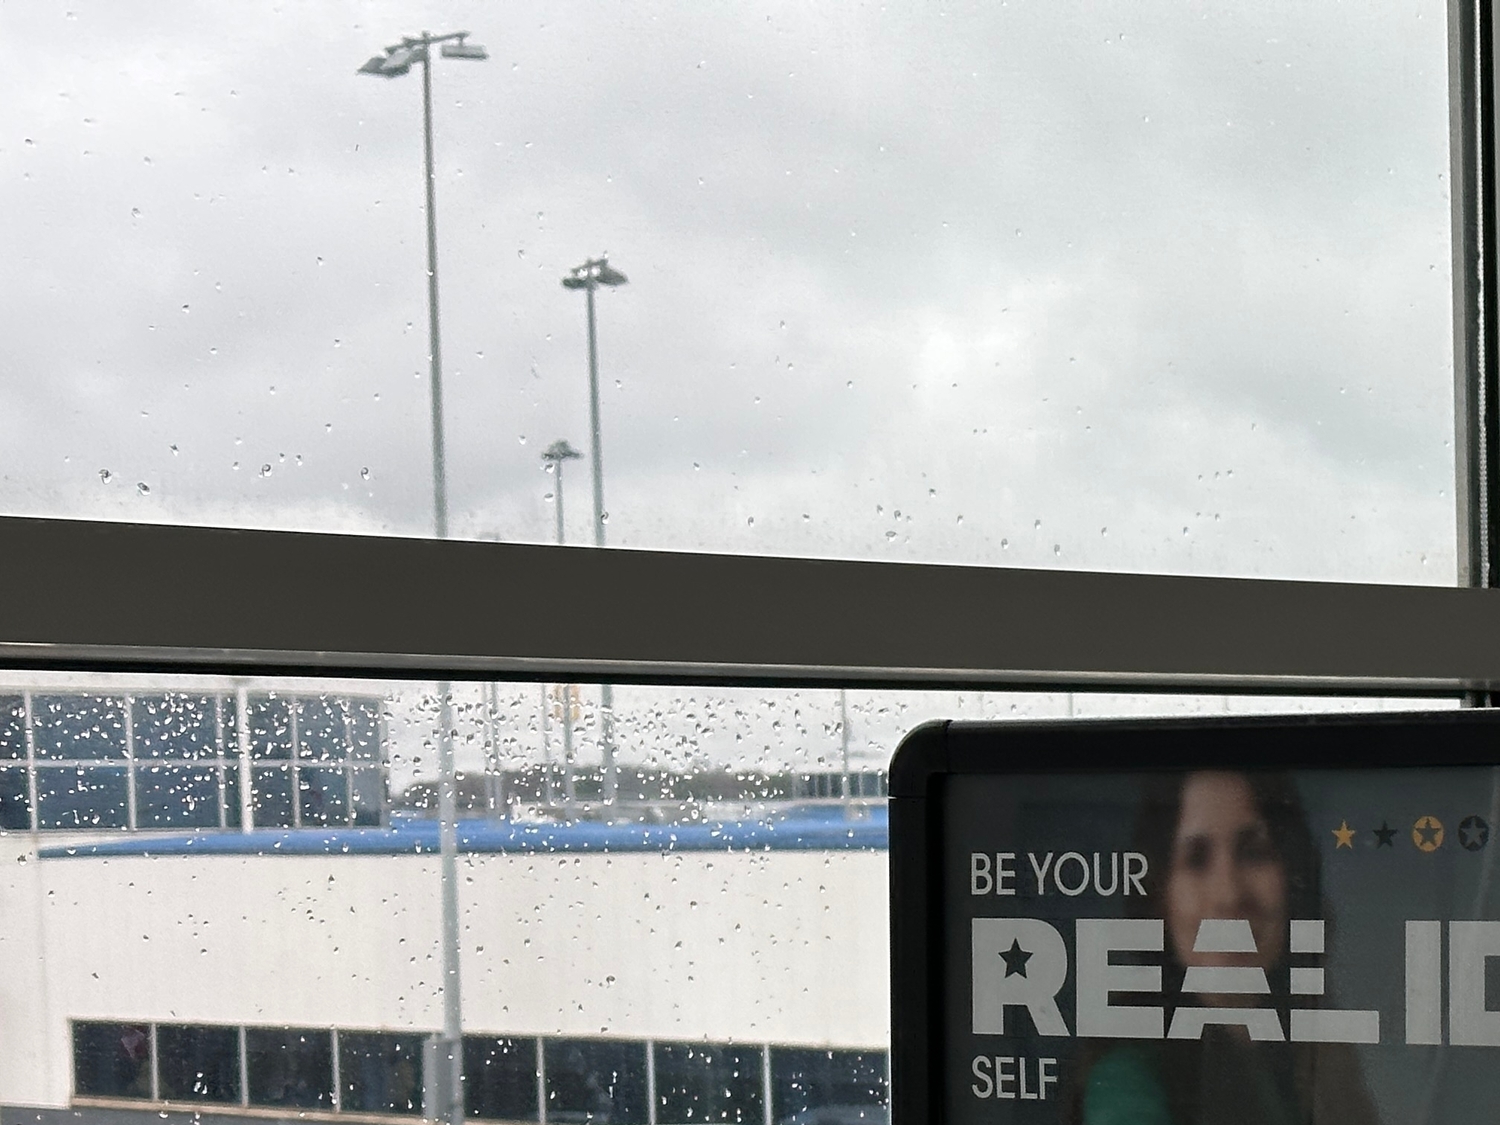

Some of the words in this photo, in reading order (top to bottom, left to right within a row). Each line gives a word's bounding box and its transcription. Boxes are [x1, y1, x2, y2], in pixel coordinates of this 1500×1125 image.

[970, 852, 1016, 896] BE
[1028, 852, 1149, 896] YOUR
[971, 917, 1380, 1043] REAL
[971, 1056, 1059, 1100] SELF
